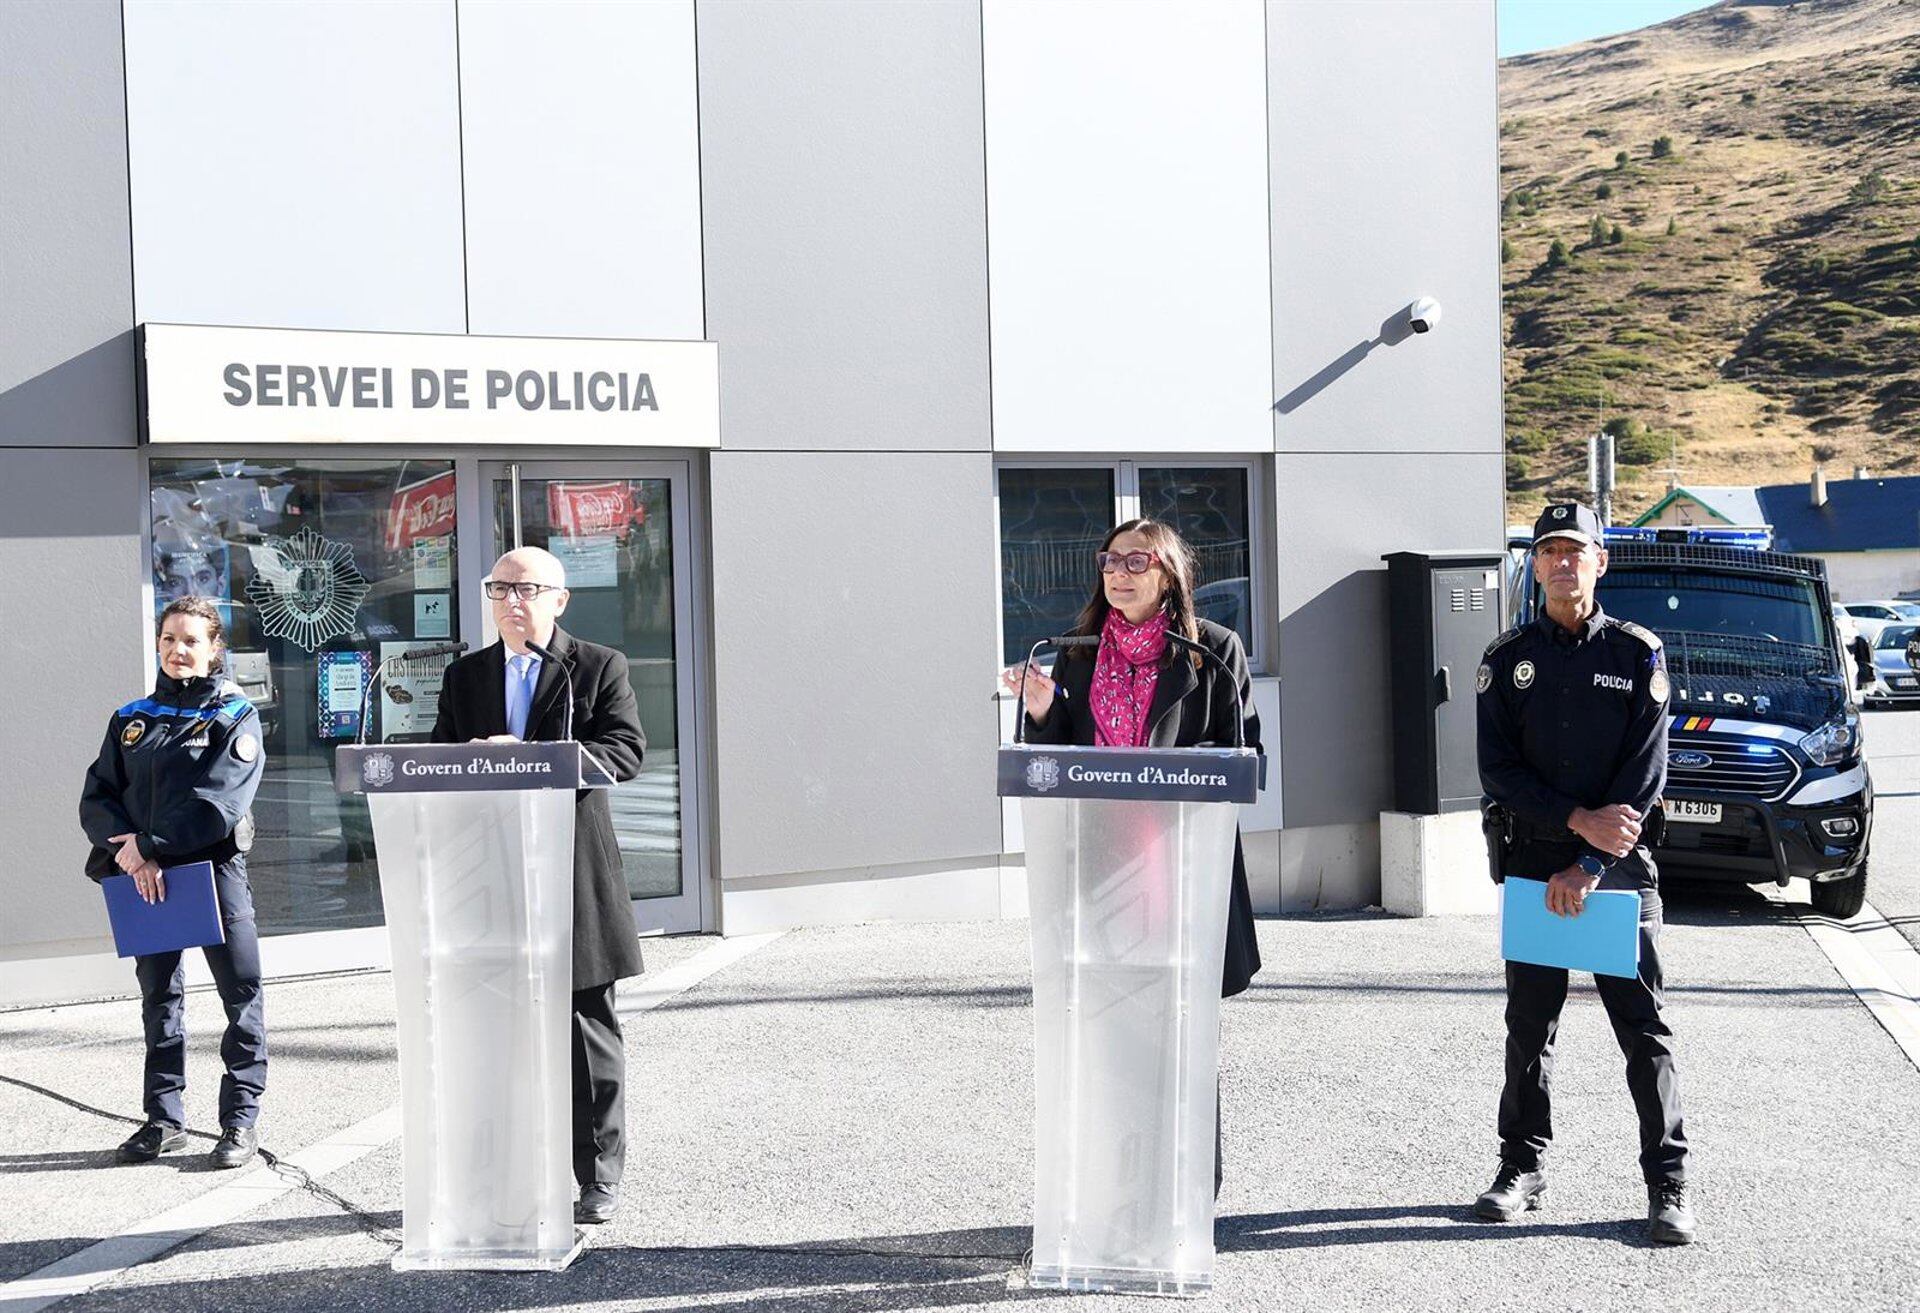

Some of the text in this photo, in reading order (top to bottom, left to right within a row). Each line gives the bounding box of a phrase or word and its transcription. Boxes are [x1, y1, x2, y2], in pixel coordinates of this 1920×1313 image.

[223, 363, 659, 411] SERVEI DE POLICIA
[1593, 673, 1633, 691] POLICIA
[402, 757, 551, 775] Govern d'Andorra
[1675, 753, 1701, 764] Ford
[1067, 765, 1228, 786] Govern d'Andorra
[1685, 801, 1718, 815] 6306
